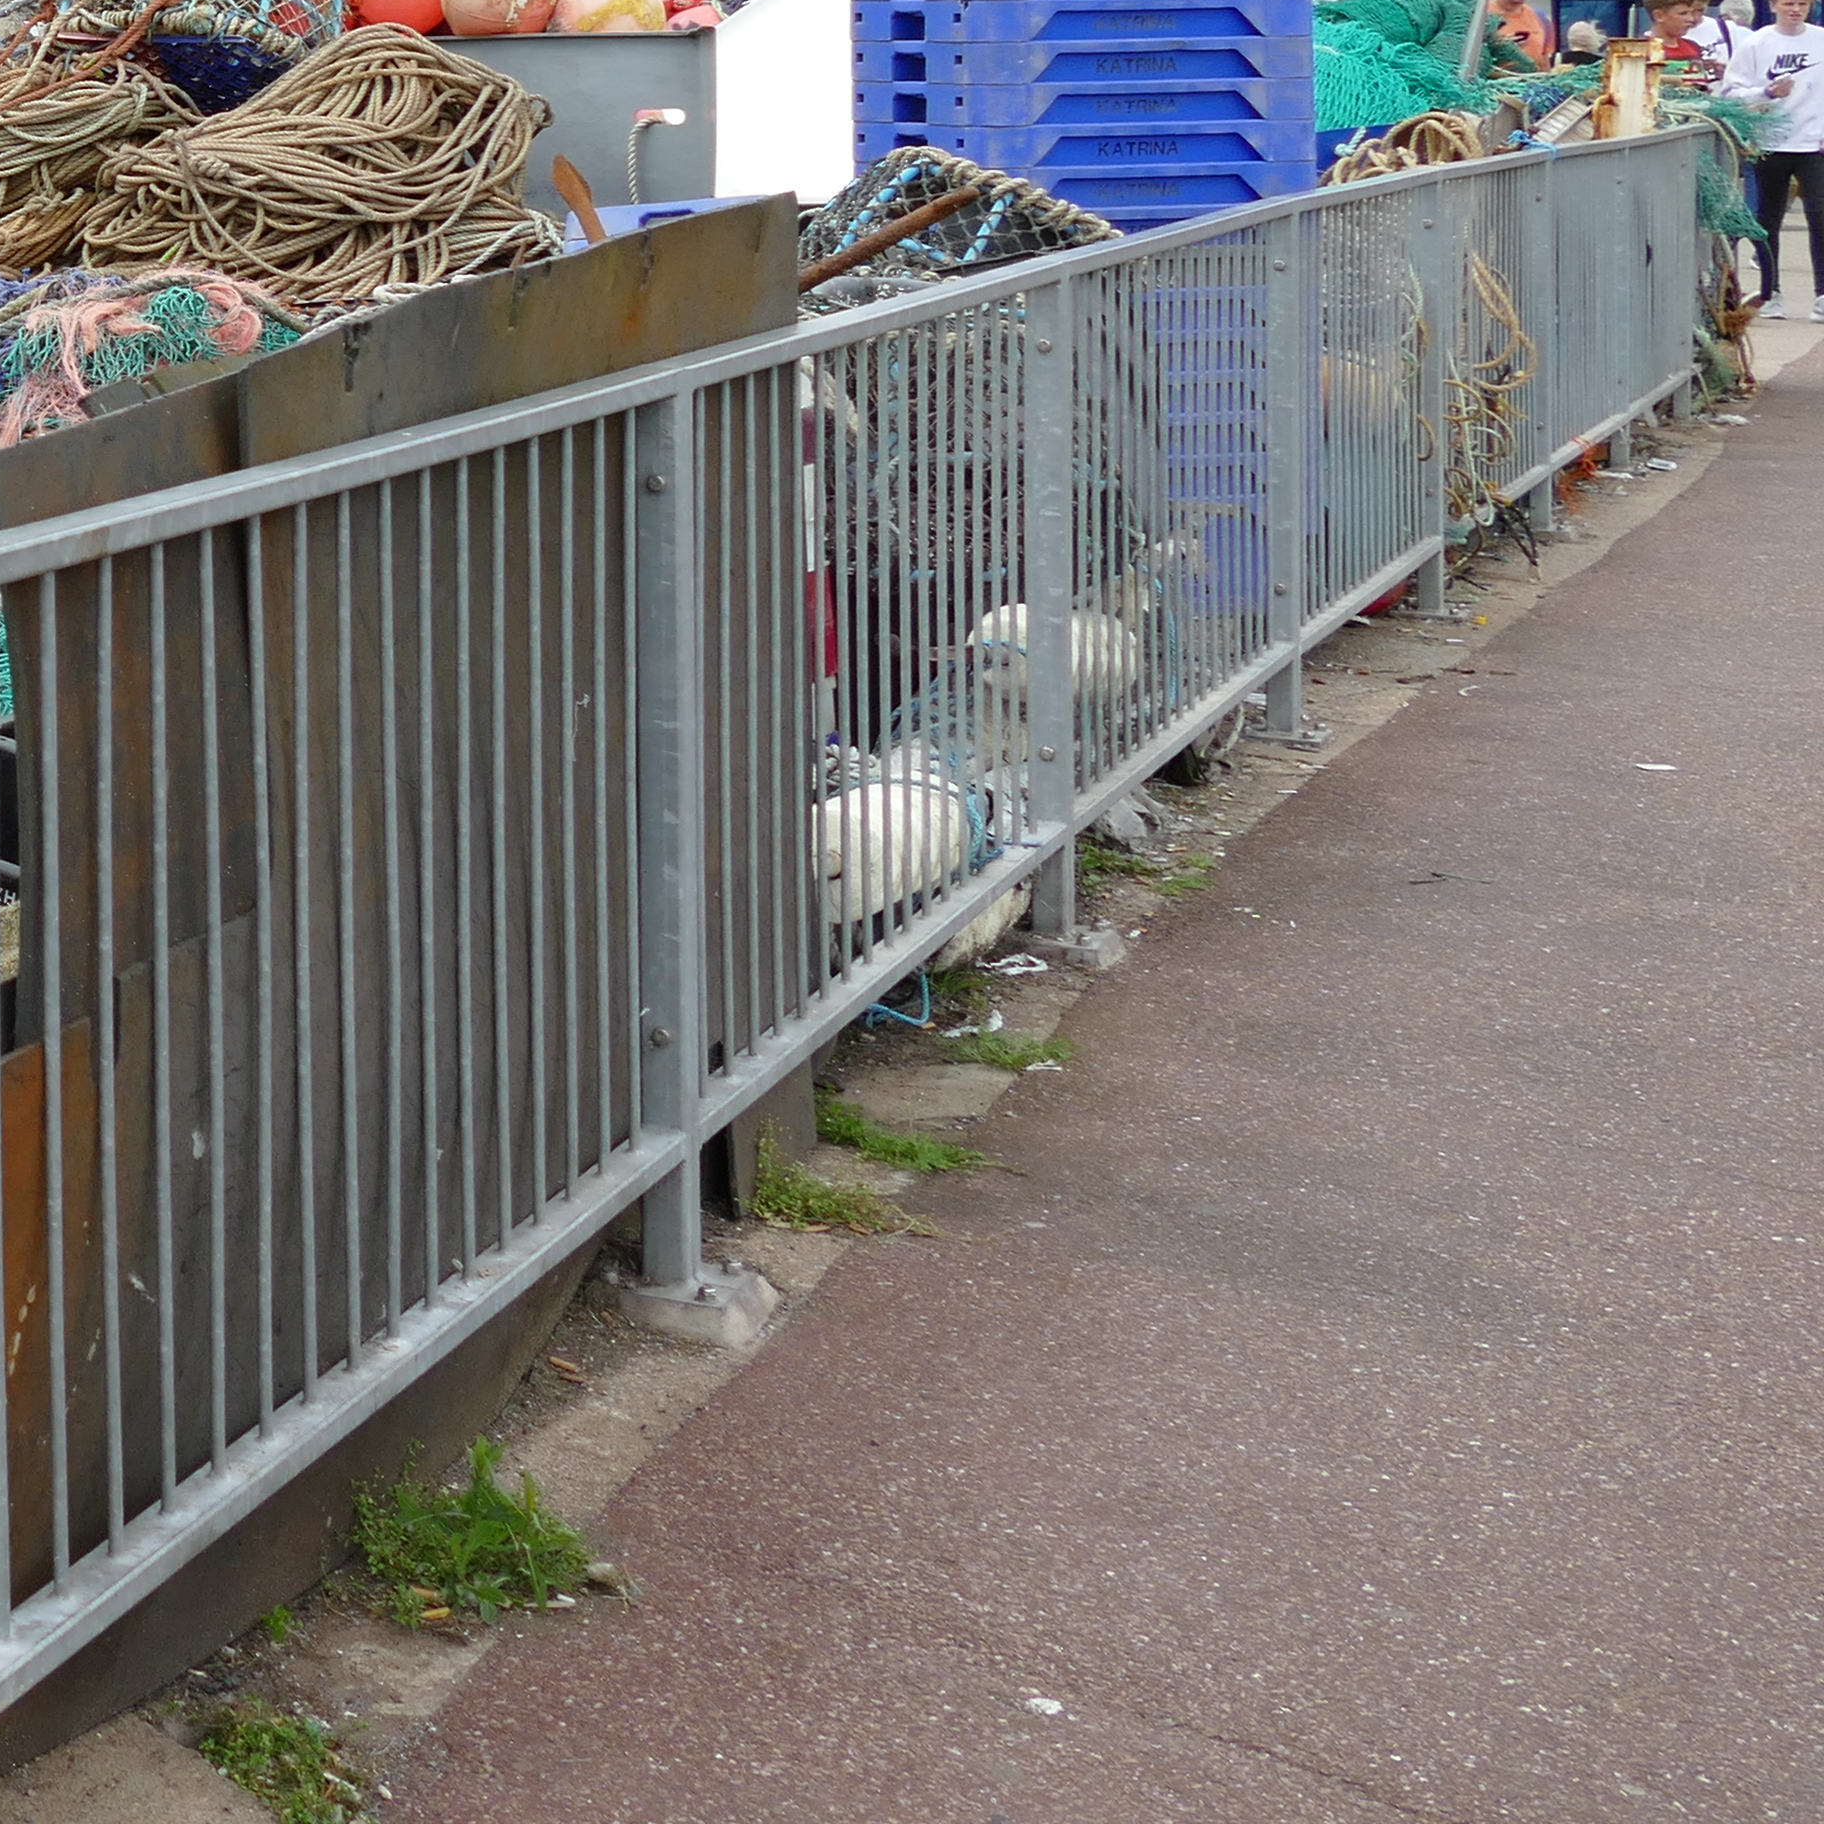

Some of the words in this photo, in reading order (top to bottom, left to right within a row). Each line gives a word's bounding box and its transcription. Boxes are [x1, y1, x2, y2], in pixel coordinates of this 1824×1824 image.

[1096, 56, 1178, 74] KATRINA
[1773, 53, 1809, 69] NIKE
[1097, 98, 1178, 115] KATRINA
[1098, 140, 1179, 157] KATRINA
